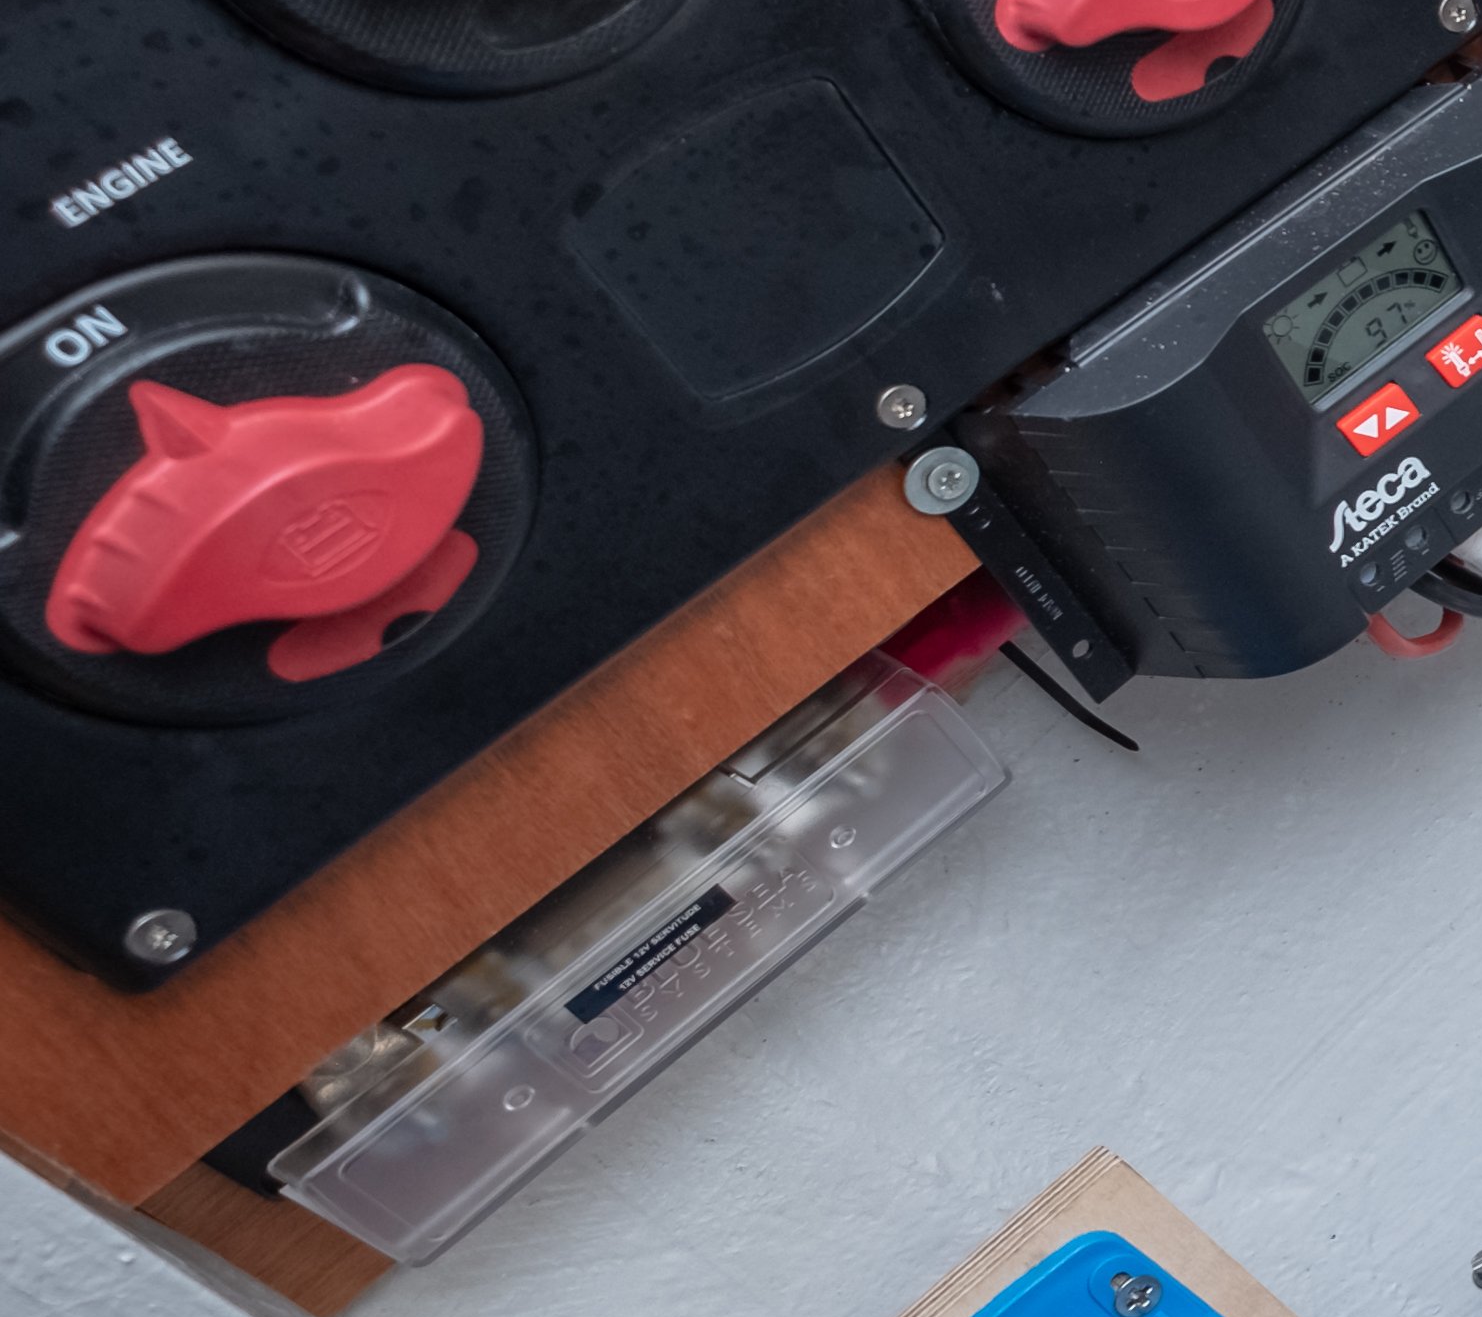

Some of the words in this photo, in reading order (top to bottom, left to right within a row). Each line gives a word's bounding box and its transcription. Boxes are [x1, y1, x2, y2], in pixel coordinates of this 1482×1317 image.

[50, 135, 194, 227] ENGINE
[45, 304, 128, 367] ON
[1327, 360, 1352, 383] SOC
[1337, 550, 1354, 568] A
[1350, 513, 1399, 557] KATEK
[1396, 480, 1440, 520] Brand
[592, 956, 634, 992] FUSIBLE
[633, 942, 651, 959] 12V
[649, 902, 702, 946] SERVITUDE
[617, 974, 637, 992] 12V
[635, 941, 677, 978] SERVICE
[674, 921, 701, 946] FUSE
